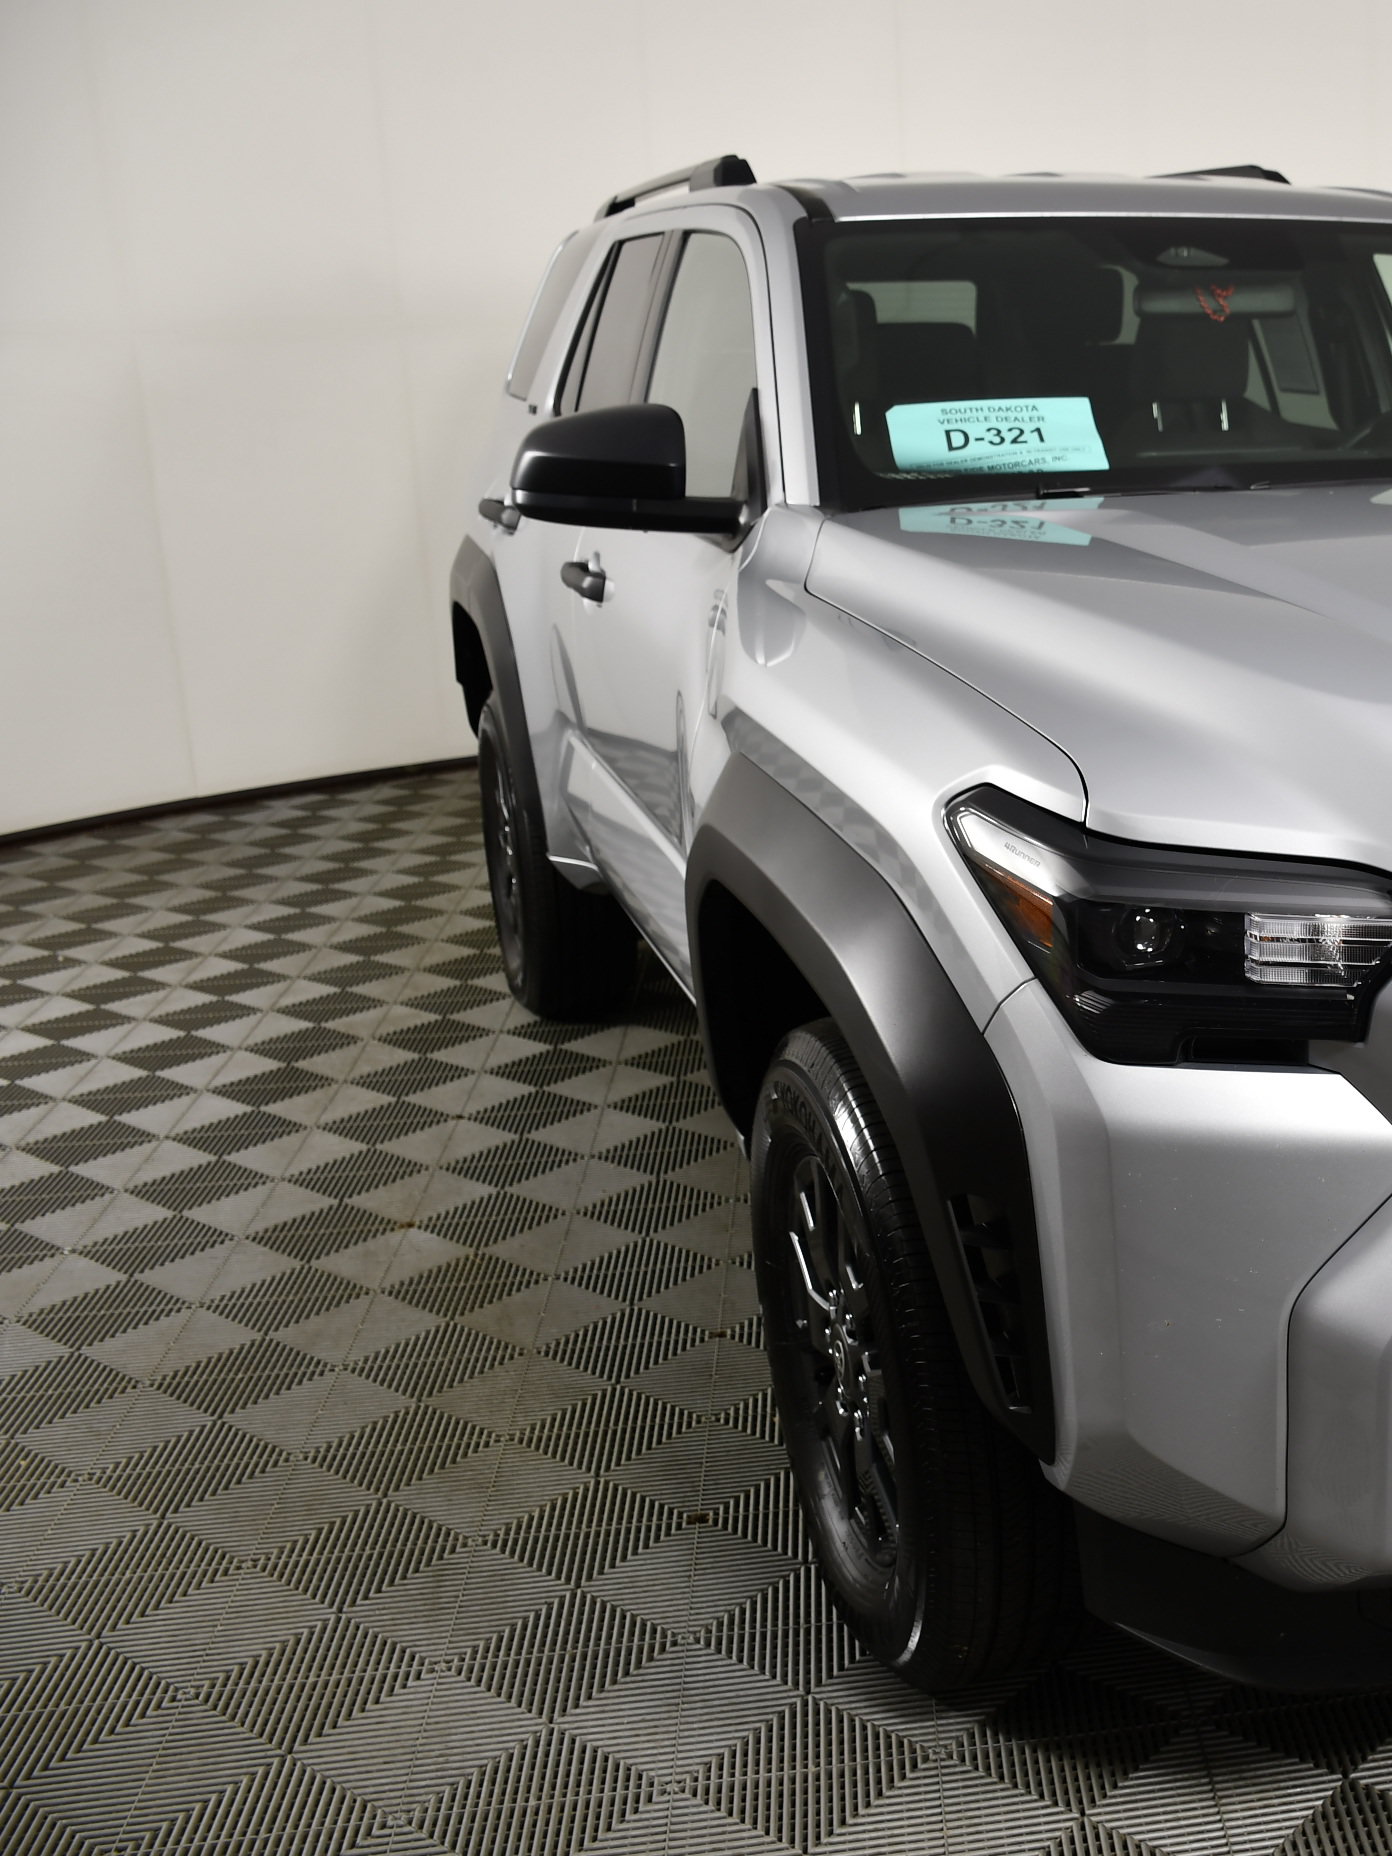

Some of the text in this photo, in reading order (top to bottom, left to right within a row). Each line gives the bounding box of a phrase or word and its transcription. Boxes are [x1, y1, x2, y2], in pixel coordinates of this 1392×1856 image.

[940, 404, 1039, 416] SOUTH DAKOTA
[938, 415, 1045, 425] VEHICLE DEALER
[944, 426, 1046, 452] D-321
